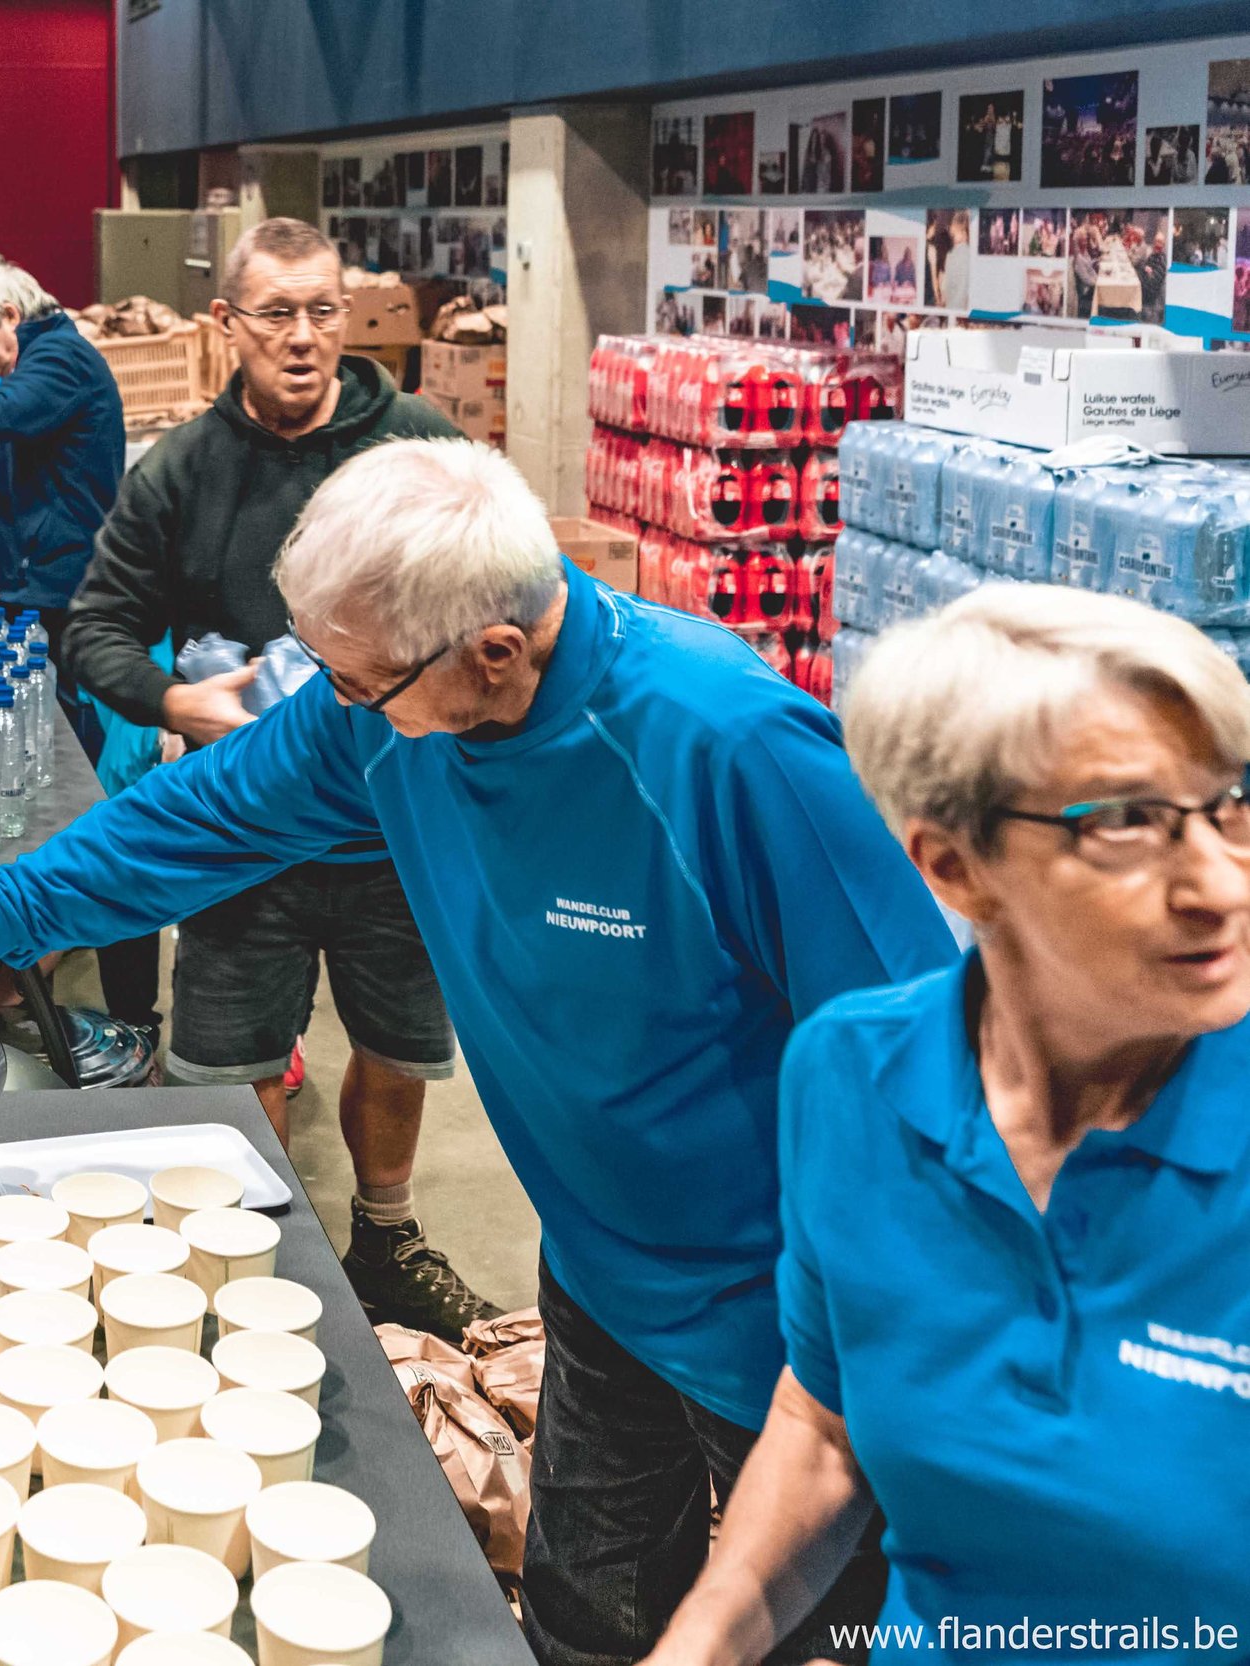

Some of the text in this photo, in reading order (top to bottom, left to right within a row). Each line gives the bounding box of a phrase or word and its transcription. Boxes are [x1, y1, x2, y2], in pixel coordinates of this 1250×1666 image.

[1083, 393, 1156, 405] Luikse wafels
[1083, 405, 1128, 416] Gaufres
[1131, 406, 1147, 416] de
[555, 896, 631, 921] WANDELCLUB
[545, 910, 647, 939] NIEUWPOORT
